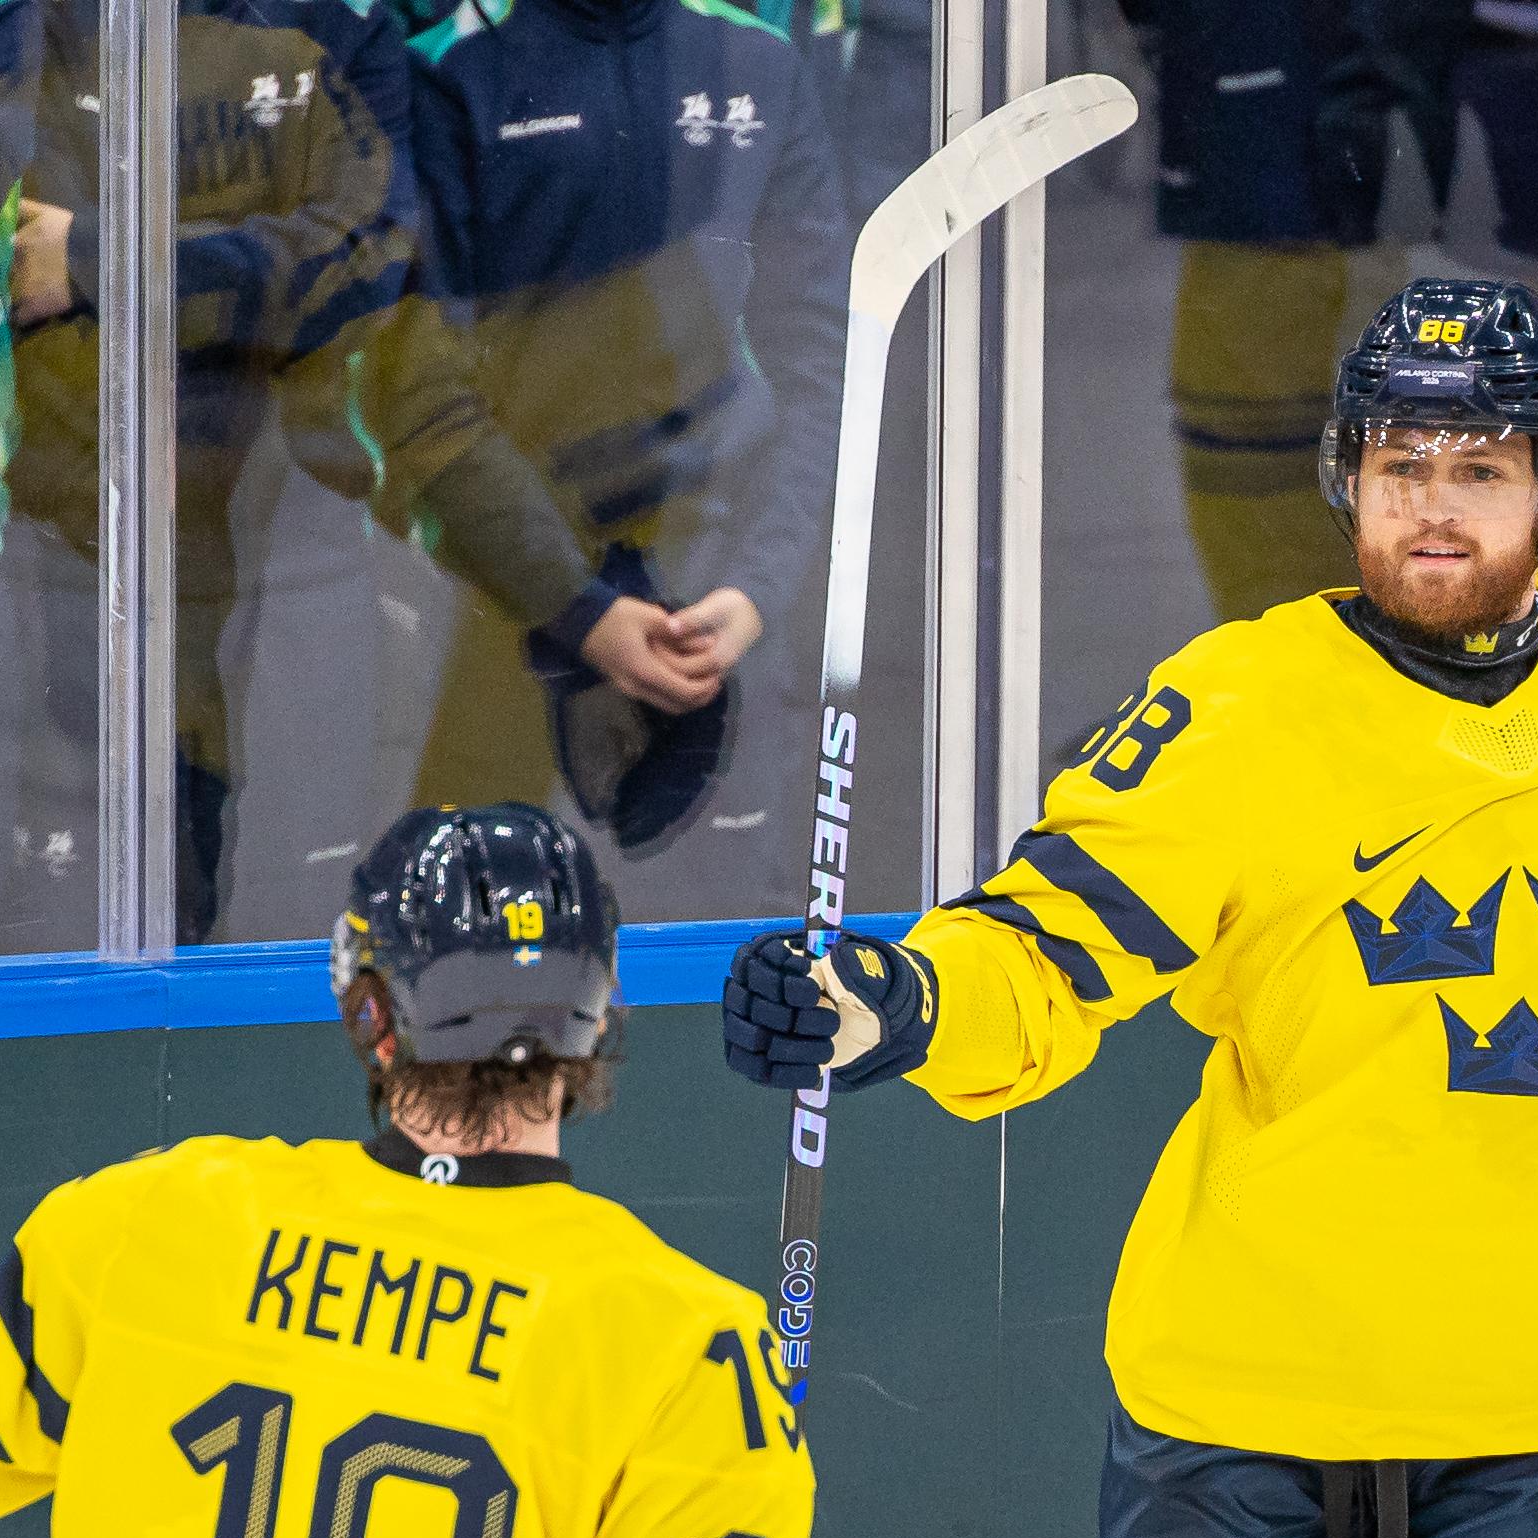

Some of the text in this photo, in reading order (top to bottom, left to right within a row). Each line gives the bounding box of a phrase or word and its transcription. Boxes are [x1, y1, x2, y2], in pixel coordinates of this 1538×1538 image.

[1418, 320, 1465, 343] 88
[1432, 370, 1468, 378] CORTINA
[502, 902, 543, 940] 19
[246, 1229, 528, 1382] KEMPE
